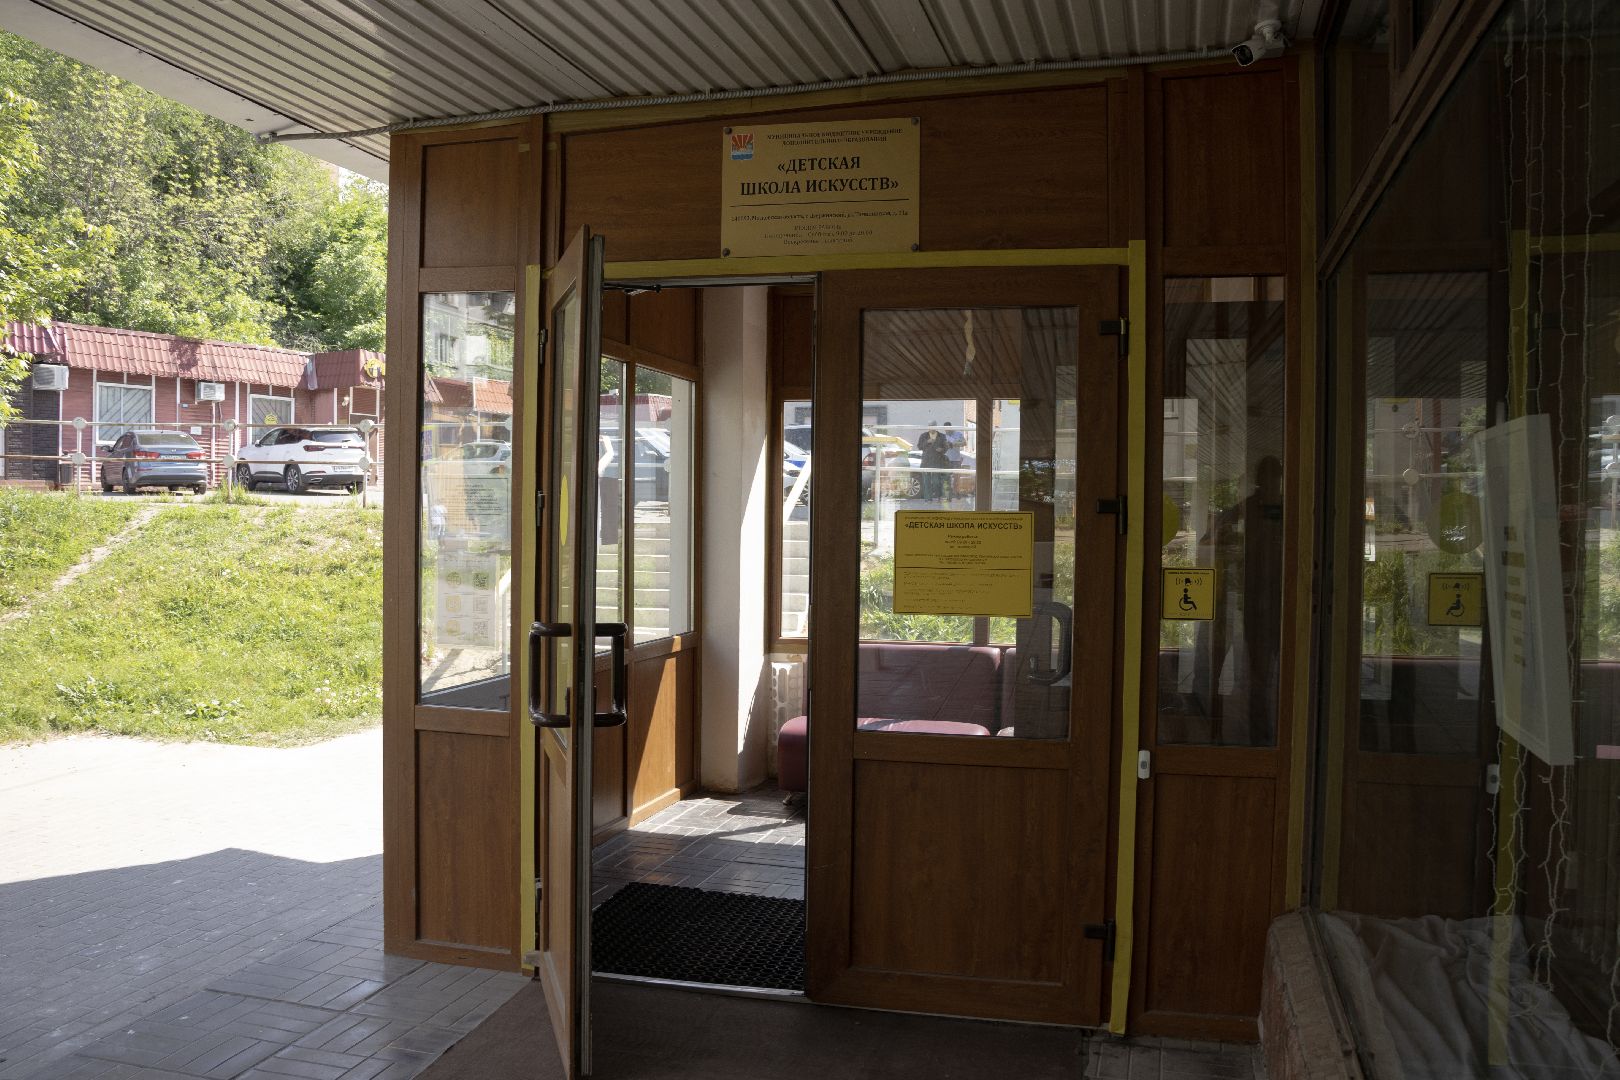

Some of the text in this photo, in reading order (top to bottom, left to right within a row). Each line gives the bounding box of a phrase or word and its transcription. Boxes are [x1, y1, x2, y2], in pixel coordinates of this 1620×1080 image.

[777, 156, 860, 174] «ДЕТСКАЯ
[740, 176, 899, 196] ШКОЛА ИСКУССТВ»
[904, 521, 1023, 530] «ДЕТСКАЯ ШКОЛА ИСКУССТВ»
